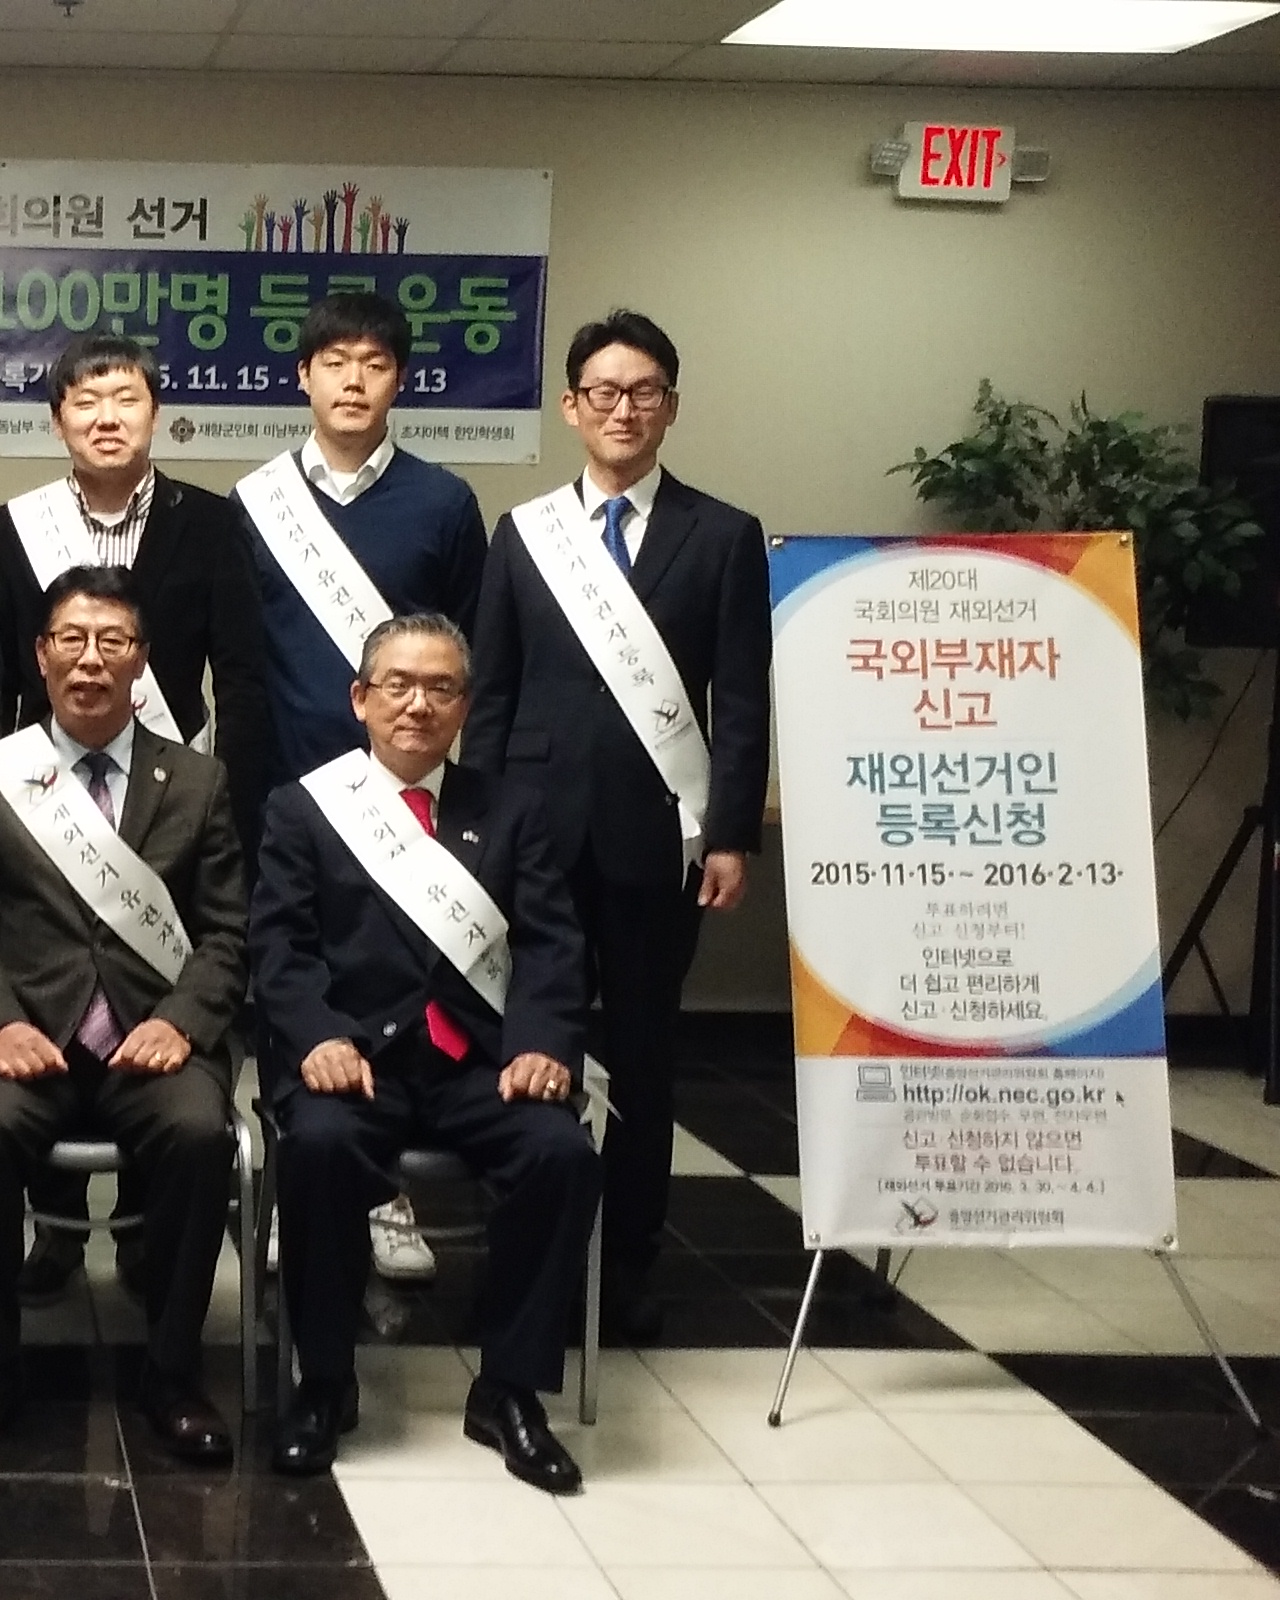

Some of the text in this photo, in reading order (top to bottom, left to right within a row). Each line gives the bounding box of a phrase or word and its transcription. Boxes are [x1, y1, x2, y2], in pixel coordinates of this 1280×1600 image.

[920, 126, 1002, 188] EXIT
[126, 196, 209, 241] 선거
[187, 365, 228, 391] 11.
[237, 365, 269, 391] 15
[414, 369, 448, 393] 13
[263, 423, 312, 439] 미남부지
[908, 567, 978, 592] 제20대
[853, 599, 1038, 624] 국회의원 재외선거
[846, 637, 1061, 681] 국외부재자
[913, 688, 998, 732] 신고
[846, 751, 1059, 796] 재외선거인
[876, 802, 1048, 848] 등록신청
[53, 803, 120, 889] 재외선거
[922, 946, 1014, 969] 인터넷으로
[900, 973, 1041, 996] 더 쉽고 편리하게
[903, 1082, 1106, 1109] http://ok.nec.go.kr
[1025, 1128, 1082, 1151] 않으면
[973, 1154, 991, 1175] 수
